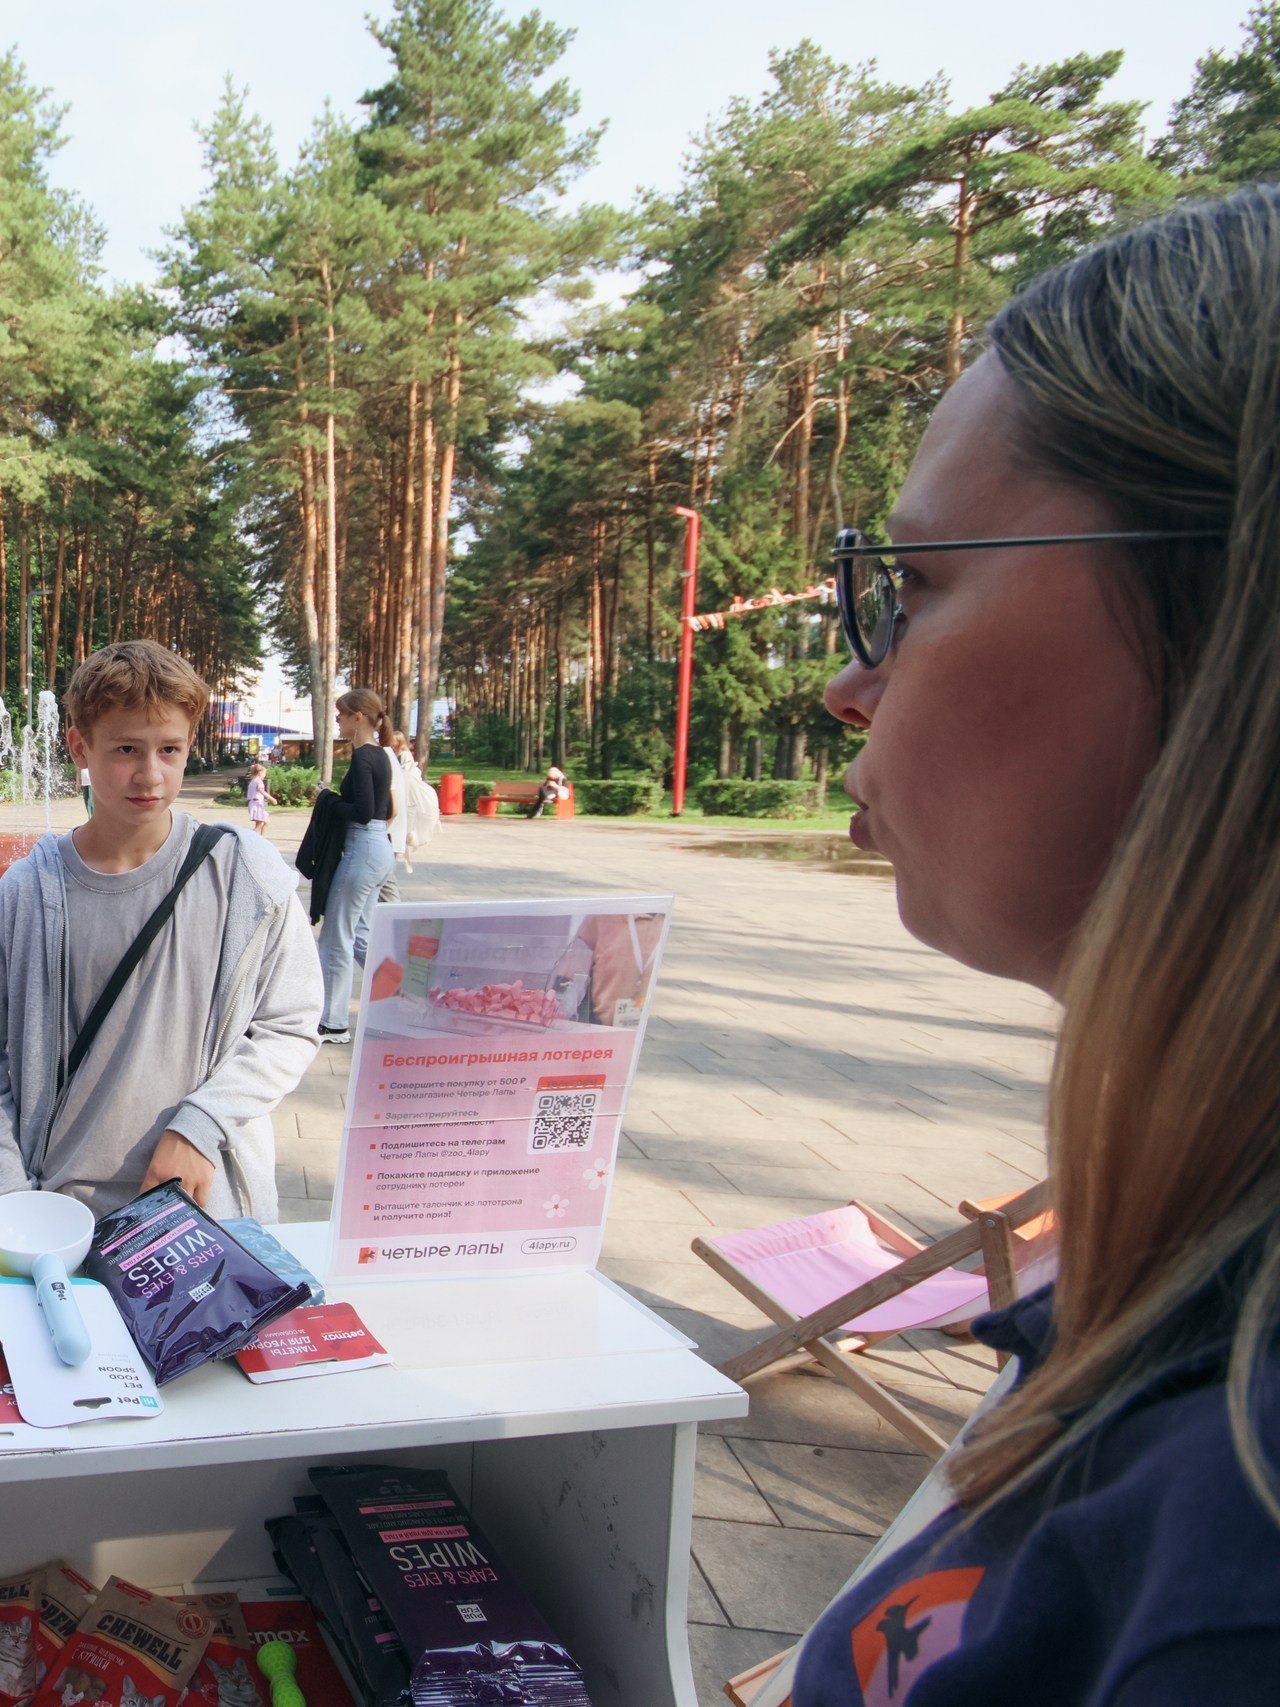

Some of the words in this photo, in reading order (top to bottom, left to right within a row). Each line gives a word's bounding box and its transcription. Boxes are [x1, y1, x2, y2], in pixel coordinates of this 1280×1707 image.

[383, 1052, 538, 1068] Беспроигрышная
[542, 1048, 613, 1063] лотерея
[390, 1080, 445, 1090] Совершите
[447, 1079, 485, 1089] покупку
[395, 1091, 455, 1099] зоомагазине
[456, 1090, 490, 1099] Четыре
[492, 1088, 516, 1097] Лапы
[385, 1109, 479, 1121] Зарегистрируйтесь
[381, 1140, 446, 1150] Подпишитесь
[461, 1138, 506, 1147] телеграм
[380, 1152, 413, 1160] Четыре
[414, 1150, 439, 1159] Лапы
[440, 1148, 490, 1158] @zoo_4lapy
[377, 1172, 425, 1180] Покажите
[427, 1169, 471, 1179] подписку
[481, 1167, 540, 1177] приложение
[376, 1182, 427, 1191] сотруднику
[428, 1180, 465, 1189] лотереи
[374, 1202, 420, 1211] Вытащите
[422, 1200, 462, 1208] талончик
[477, 1198, 522, 1206] лототрона
[381, 1212, 425, 1221] получите
[427, 1211, 451, 1219] приз!
[381, 1244, 451, 1260] четыре
[455, 1242, 504, 1256] лапы
[528, 1240, 570, 1250] 4lapy.ru
[121, 1246, 135, 1257] AND
[188, 1244, 225, 1268] EARS
[128, 1229, 216, 1288] WIPES
[175, 1264, 188, 1275] &
[141, 1272, 176, 1299] EYES
[287, 1336, 311, 1344] ДЛЯ
[322, 1329, 365, 1341] petmax
[243, 1338, 287, 1350] УБОРКИ
[271, 1344, 318, 1356] ПАКЕТЫ
[389, 1541, 489, 1571] WIPES
[404, 1572, 442, 1588] EYES
[443, 1571, 456, 1585] &
[457, 1568, 498, 1584] EARS
[96, 1614, 183, 1670] CHEWELL
